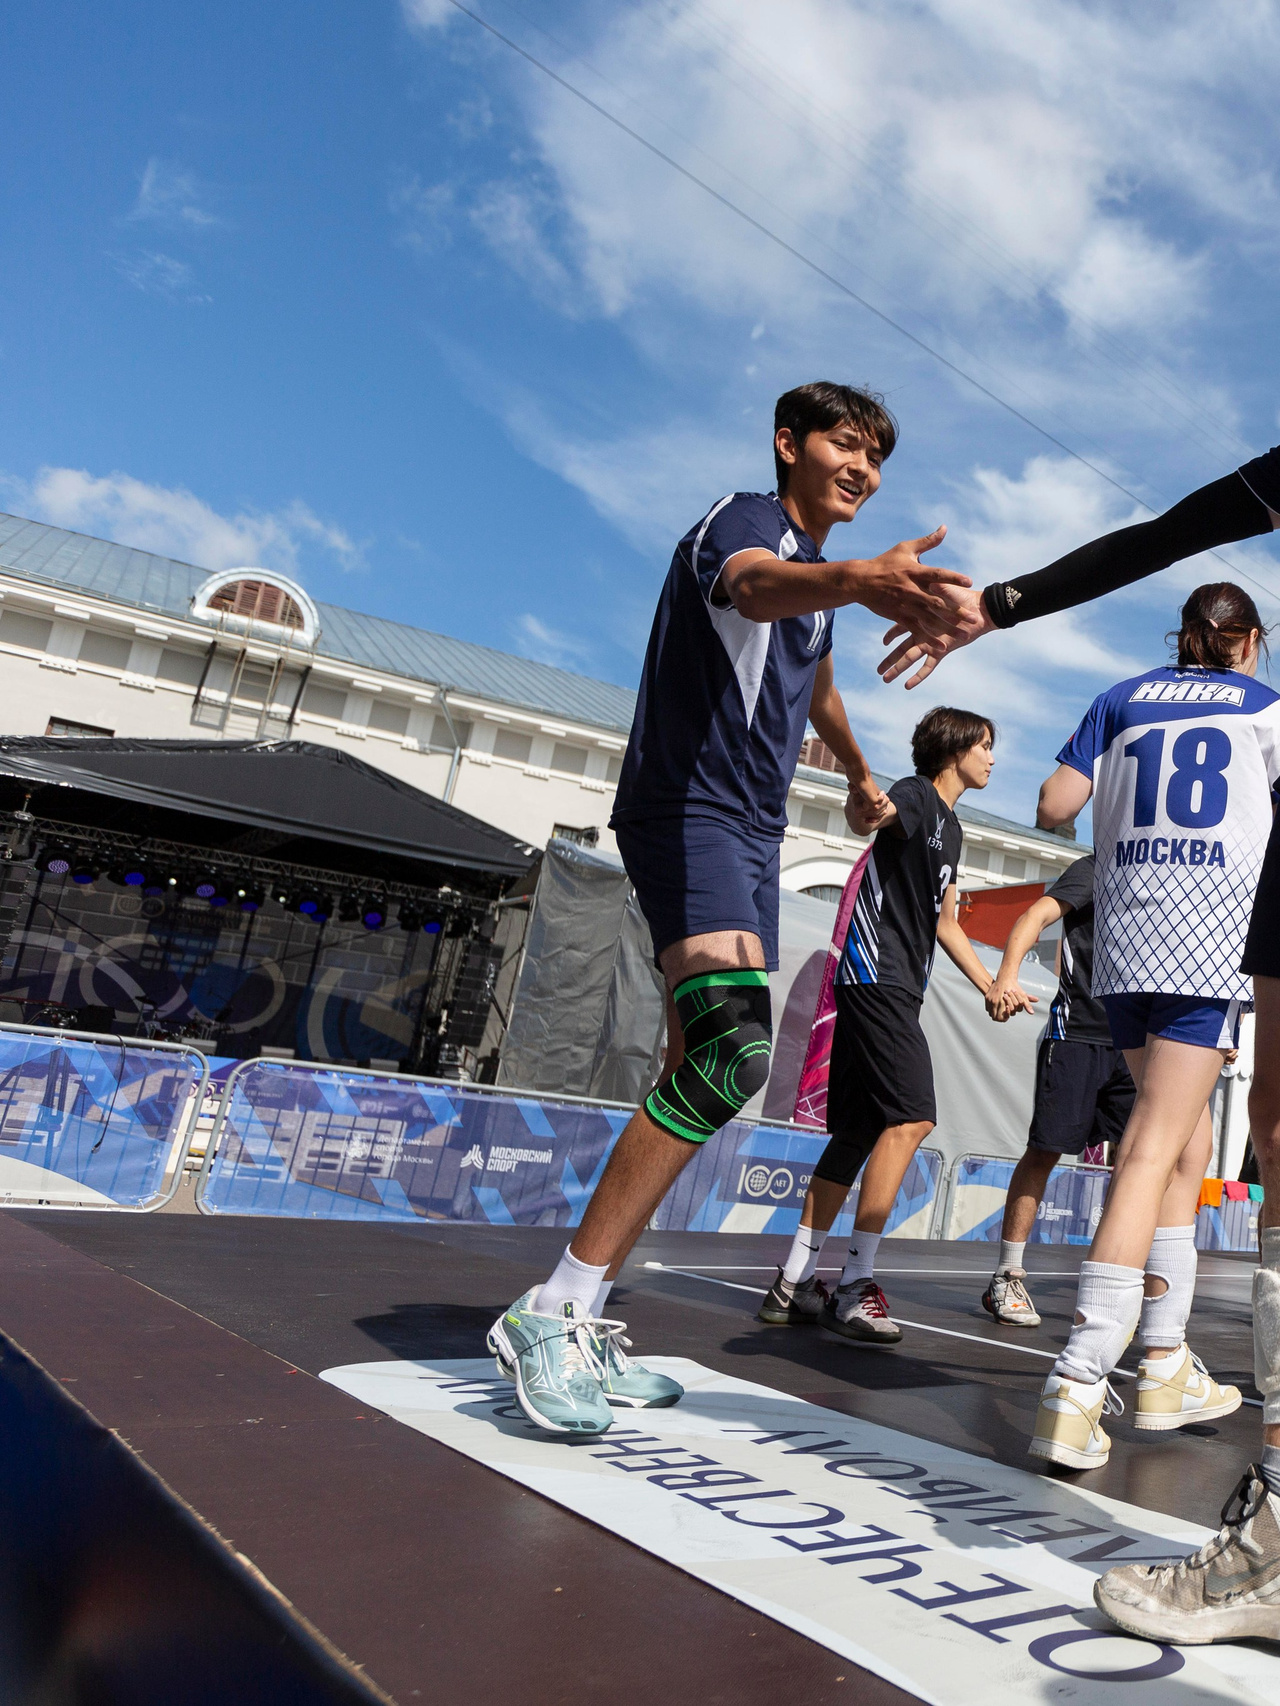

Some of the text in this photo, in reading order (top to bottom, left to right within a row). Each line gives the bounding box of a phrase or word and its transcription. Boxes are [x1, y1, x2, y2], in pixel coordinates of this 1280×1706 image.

[1130, 681, 1243, 705] НИКА
[1125, 727, 1232, 829] 18
[927, 836, 943, 851] 1373
[1116, 837, 1226, 868] МОСКВА
[403, 1155, 433, 1165] Москвы
[489, 1146, 553, 1164] МОСКОВСКИЙ
[486, 1160, 518, 1173] СПОРТ
